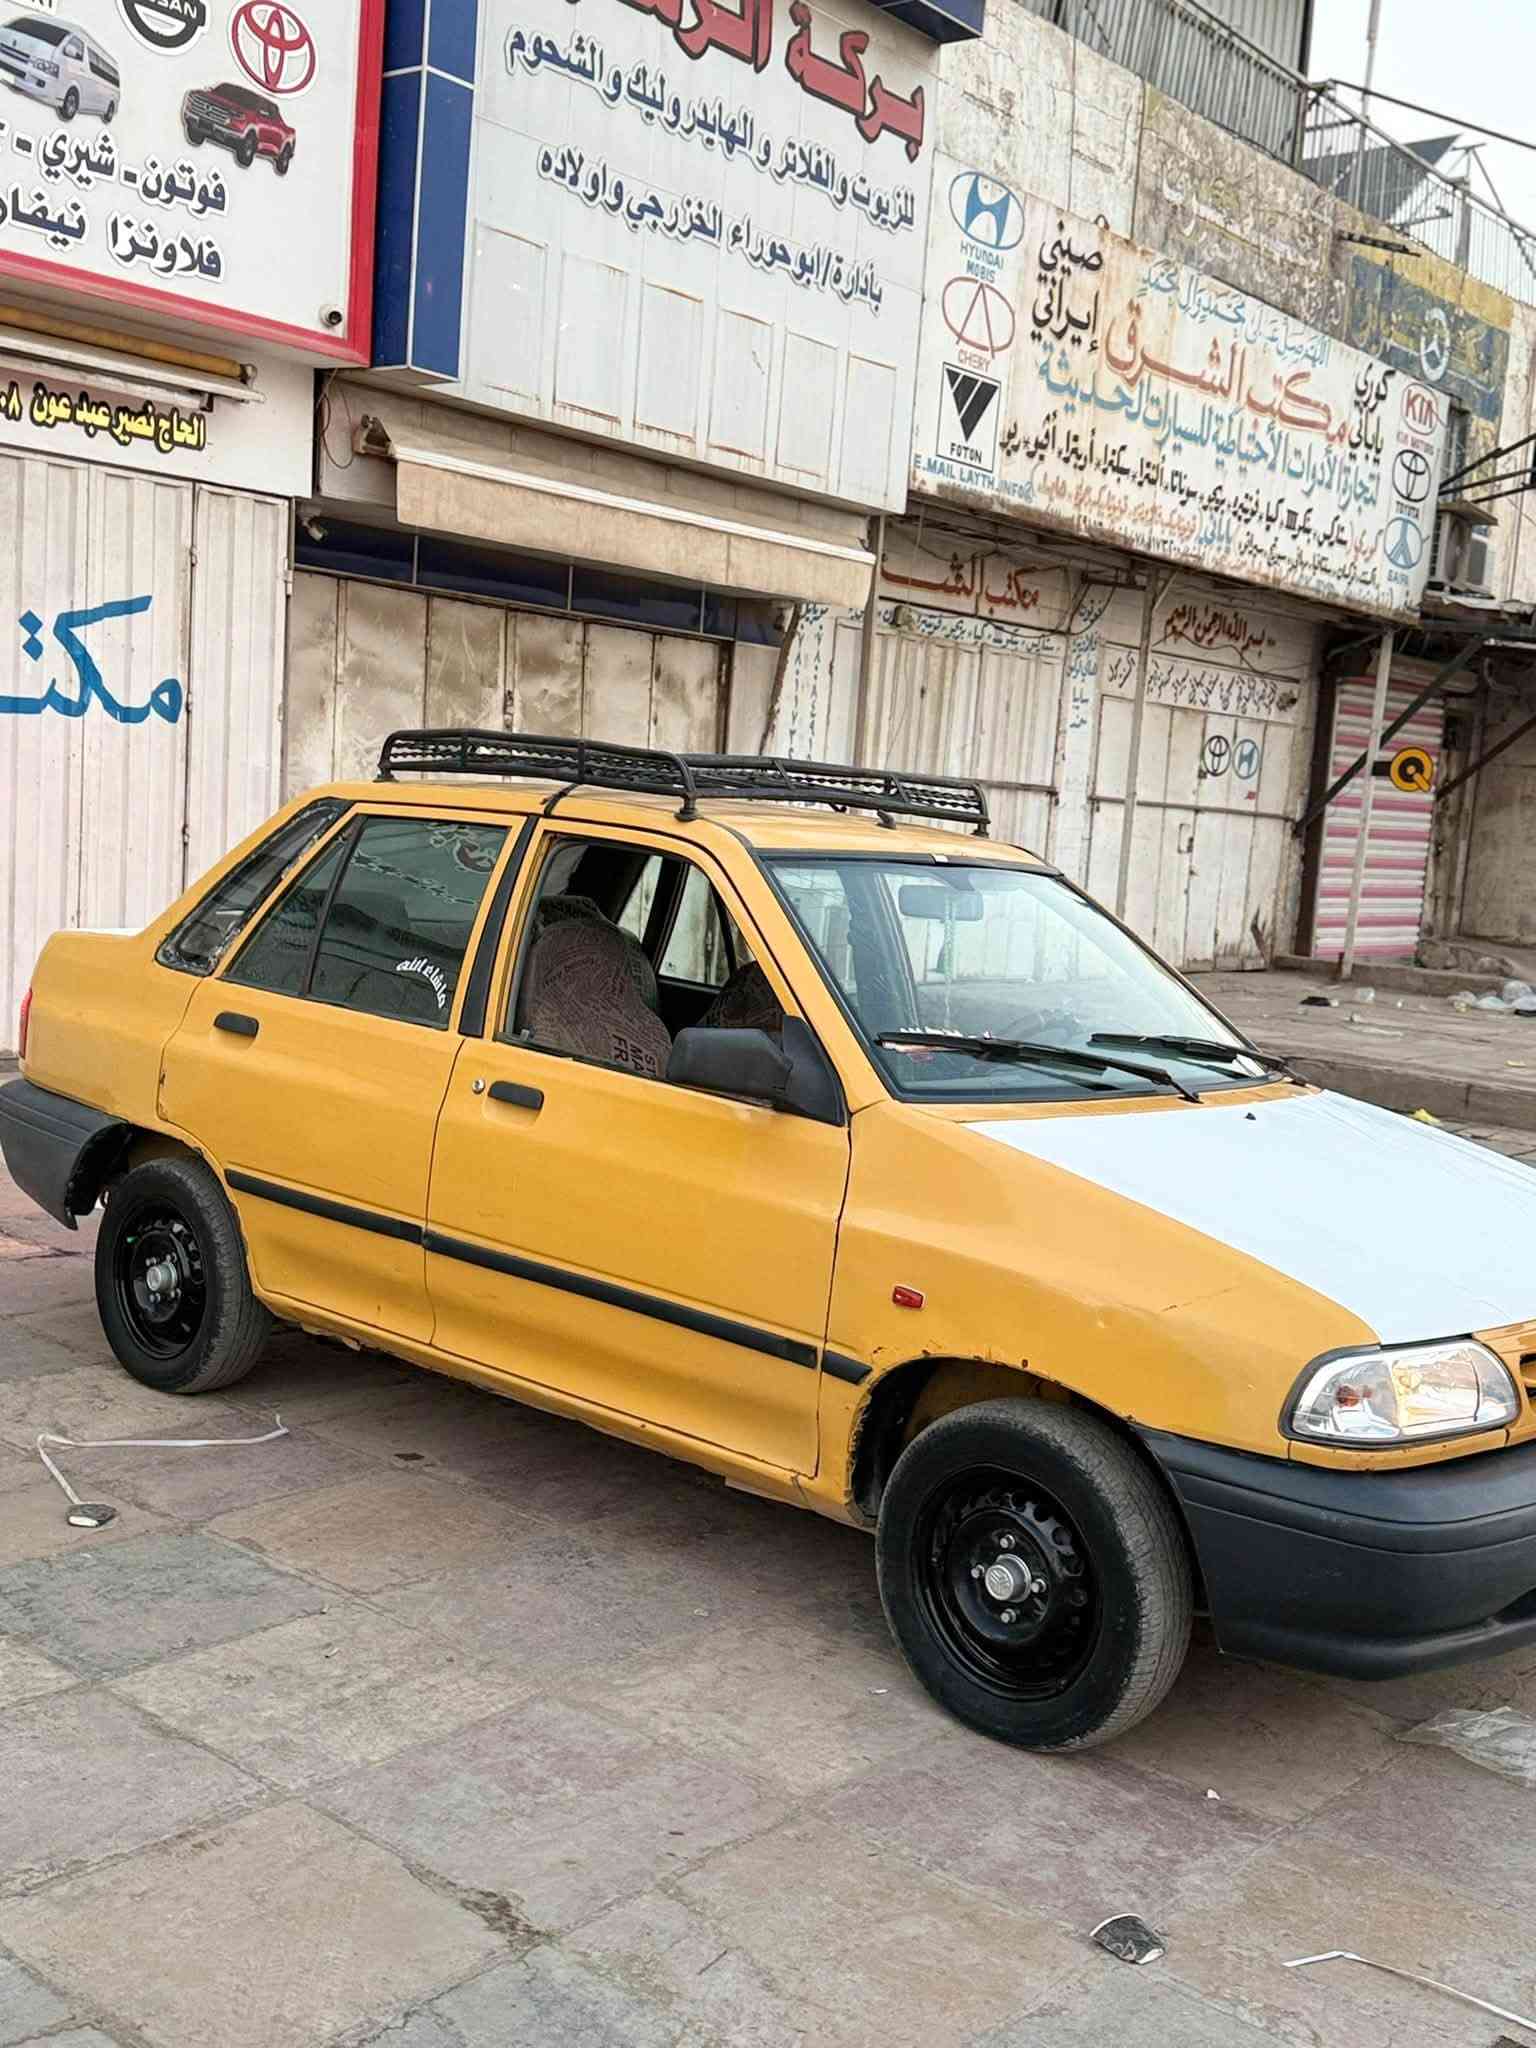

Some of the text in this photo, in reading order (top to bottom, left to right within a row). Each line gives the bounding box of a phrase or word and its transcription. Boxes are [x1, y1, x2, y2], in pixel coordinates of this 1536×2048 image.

[786, 4, 925, 162] بركة
[43, 133, 227, 215] فوتون شيري
[625, 194, 722, 242] الخزرجي
[852, 176, 914, 230] للزيوت
[110, 216, 222, 279] فلاونزا
[959, 240, 1004, 270] HYUNDAI
[966, 259, 996, 284] MOBIS
[1037, 219, 1104, 286] صيني
[1030, 276, 1101, 353] إيراني
[957, 348, 991, 372] CHERY
[1105, 297, 1249, 403] الشرق
[30, 381, 73, 428] عون
[1038, 340, 1151, 421] الحديثة
[1248, 368, 1350, 444] مكتب
[1354, 362, 1396, 414] كوري
[74, 390, 112, 437] عبد
[113, 402, 157, 446] نصير
[156, 407, 206, 452] الحاج
[1404, 388, 1435, 429] KIA
[949, 442, 983, 465] FOTON
[1349, 409, 1382, 465] ياباني
[984, 565, 1040, 616] مكتب
